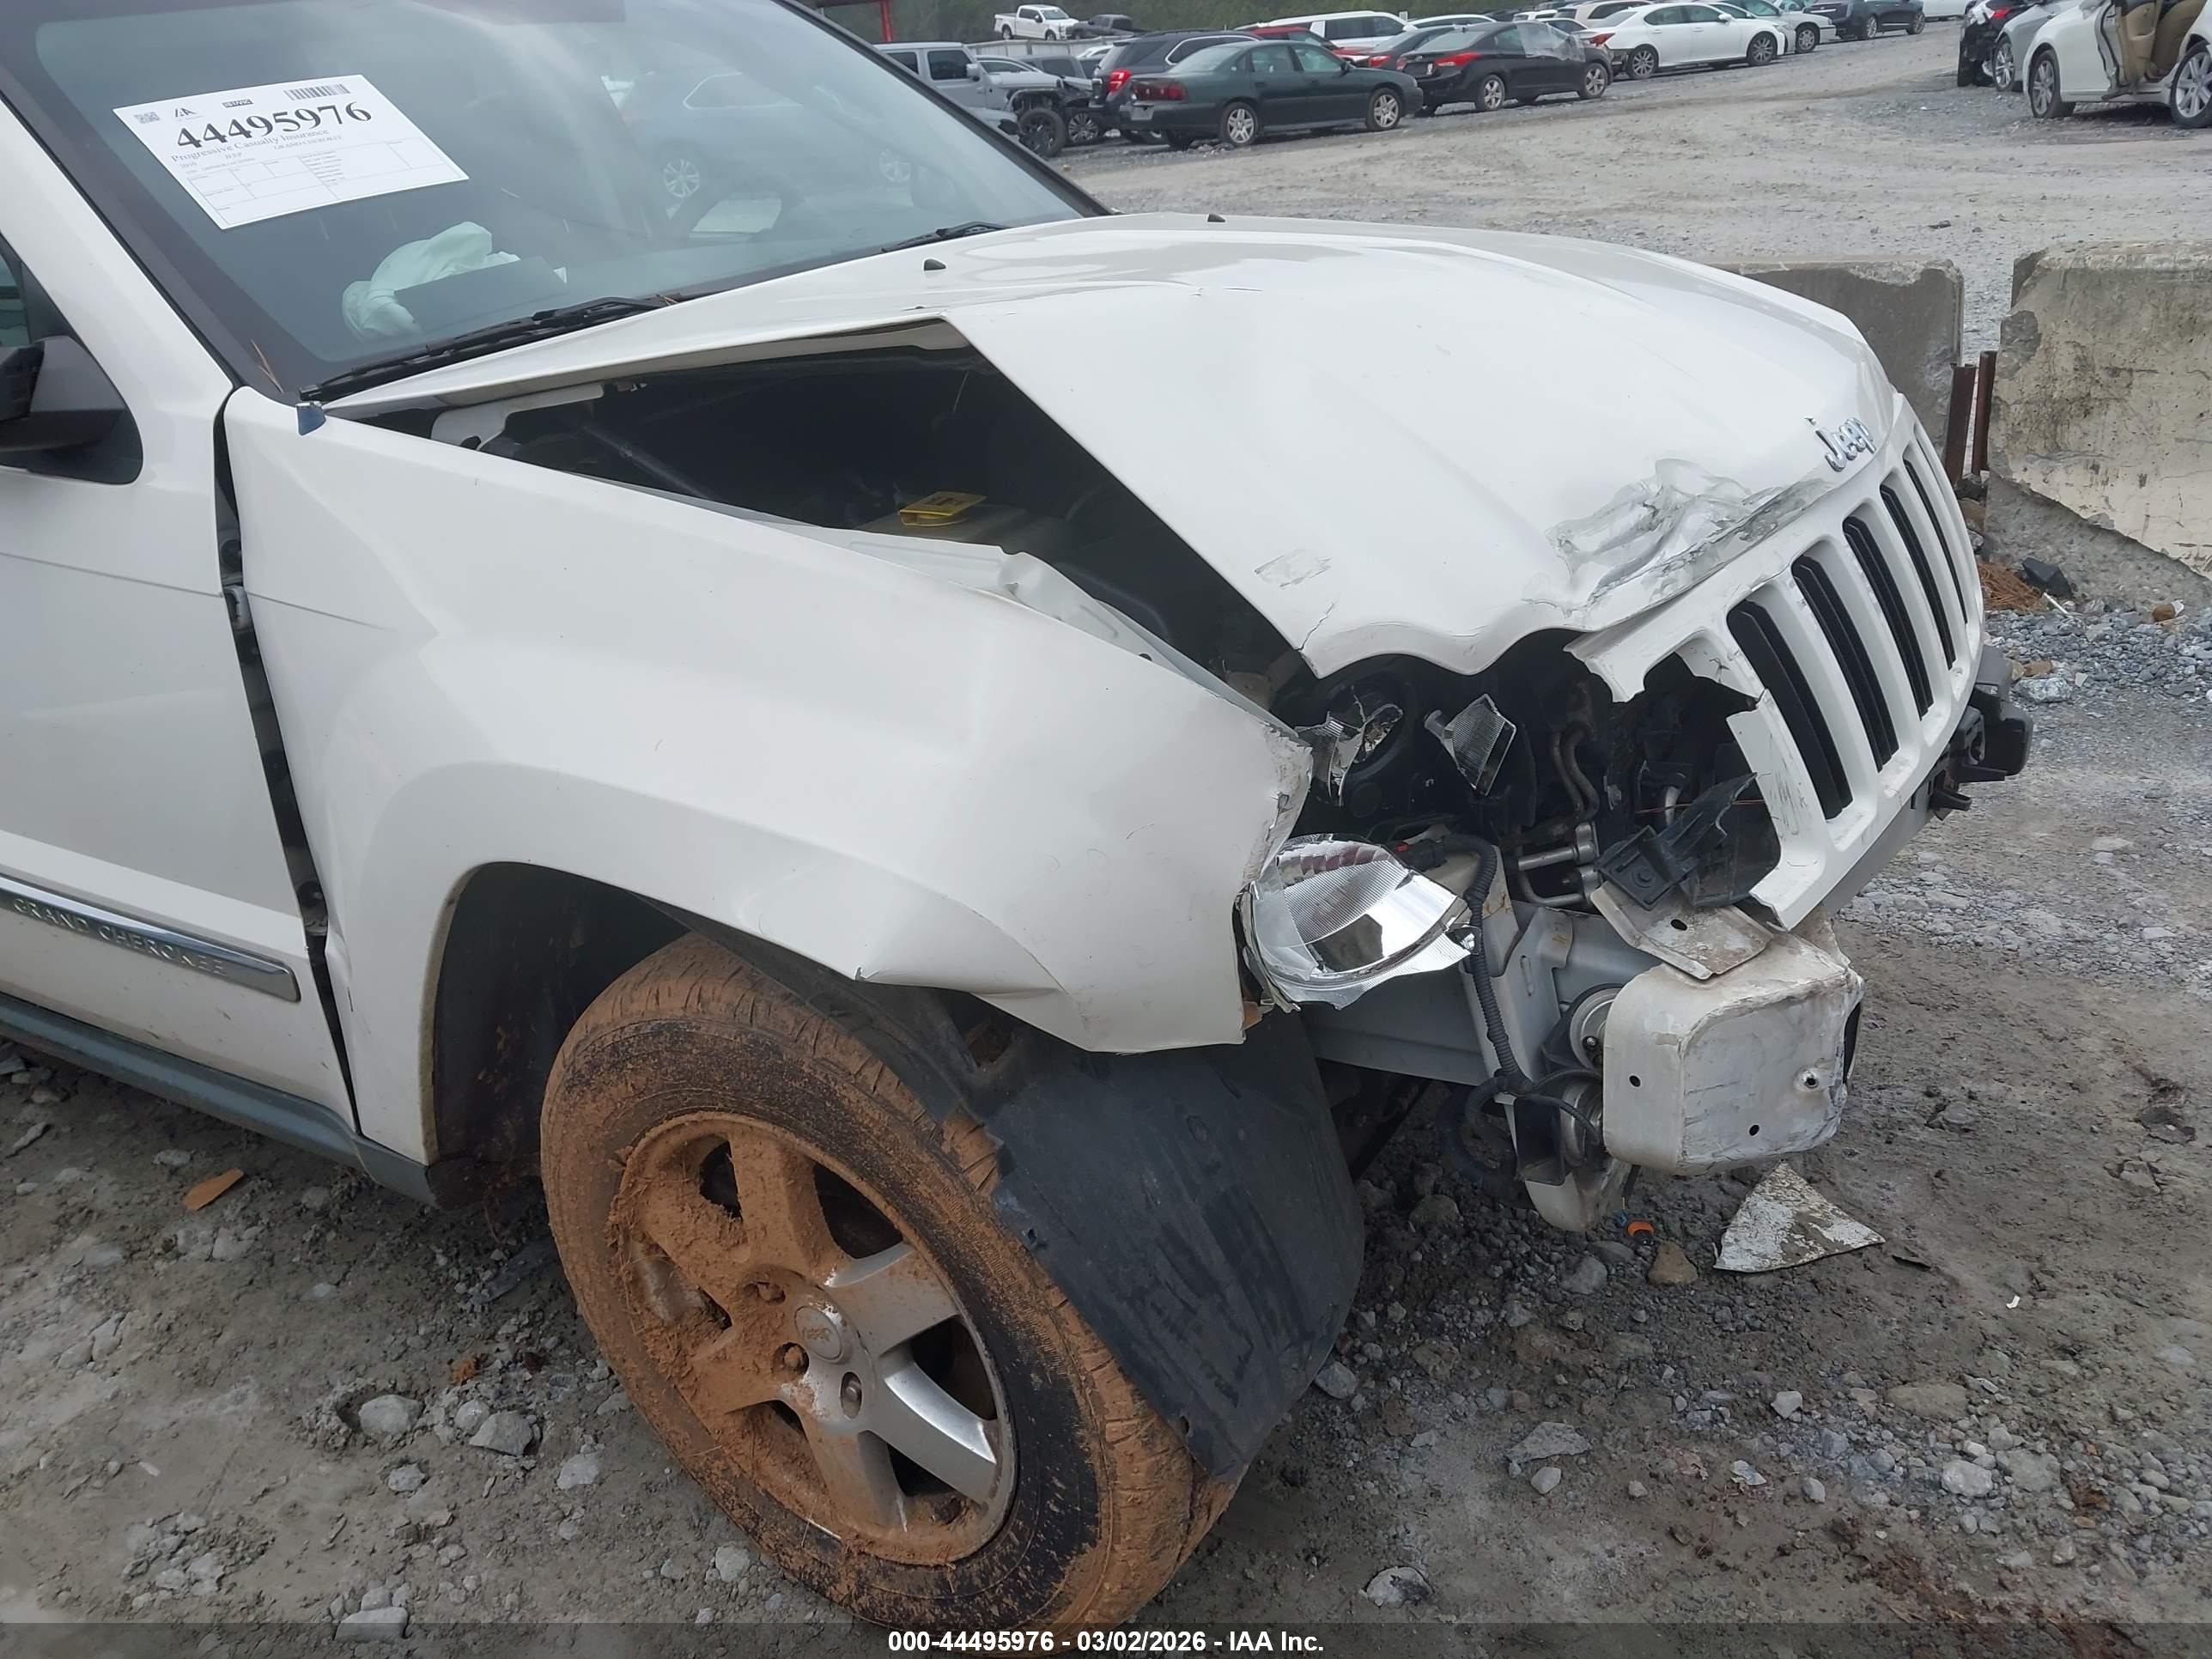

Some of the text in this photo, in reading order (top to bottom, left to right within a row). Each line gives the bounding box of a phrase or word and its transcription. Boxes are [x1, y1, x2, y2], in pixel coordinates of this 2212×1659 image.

[171, 129, 329, 162] Progressive Casualty Insurance
[177, 100, 373, 149] 44495976
[1815, 417, 1877, 472] Jeep
[13, 897, 228, 976] GRAND CHEROKEE
